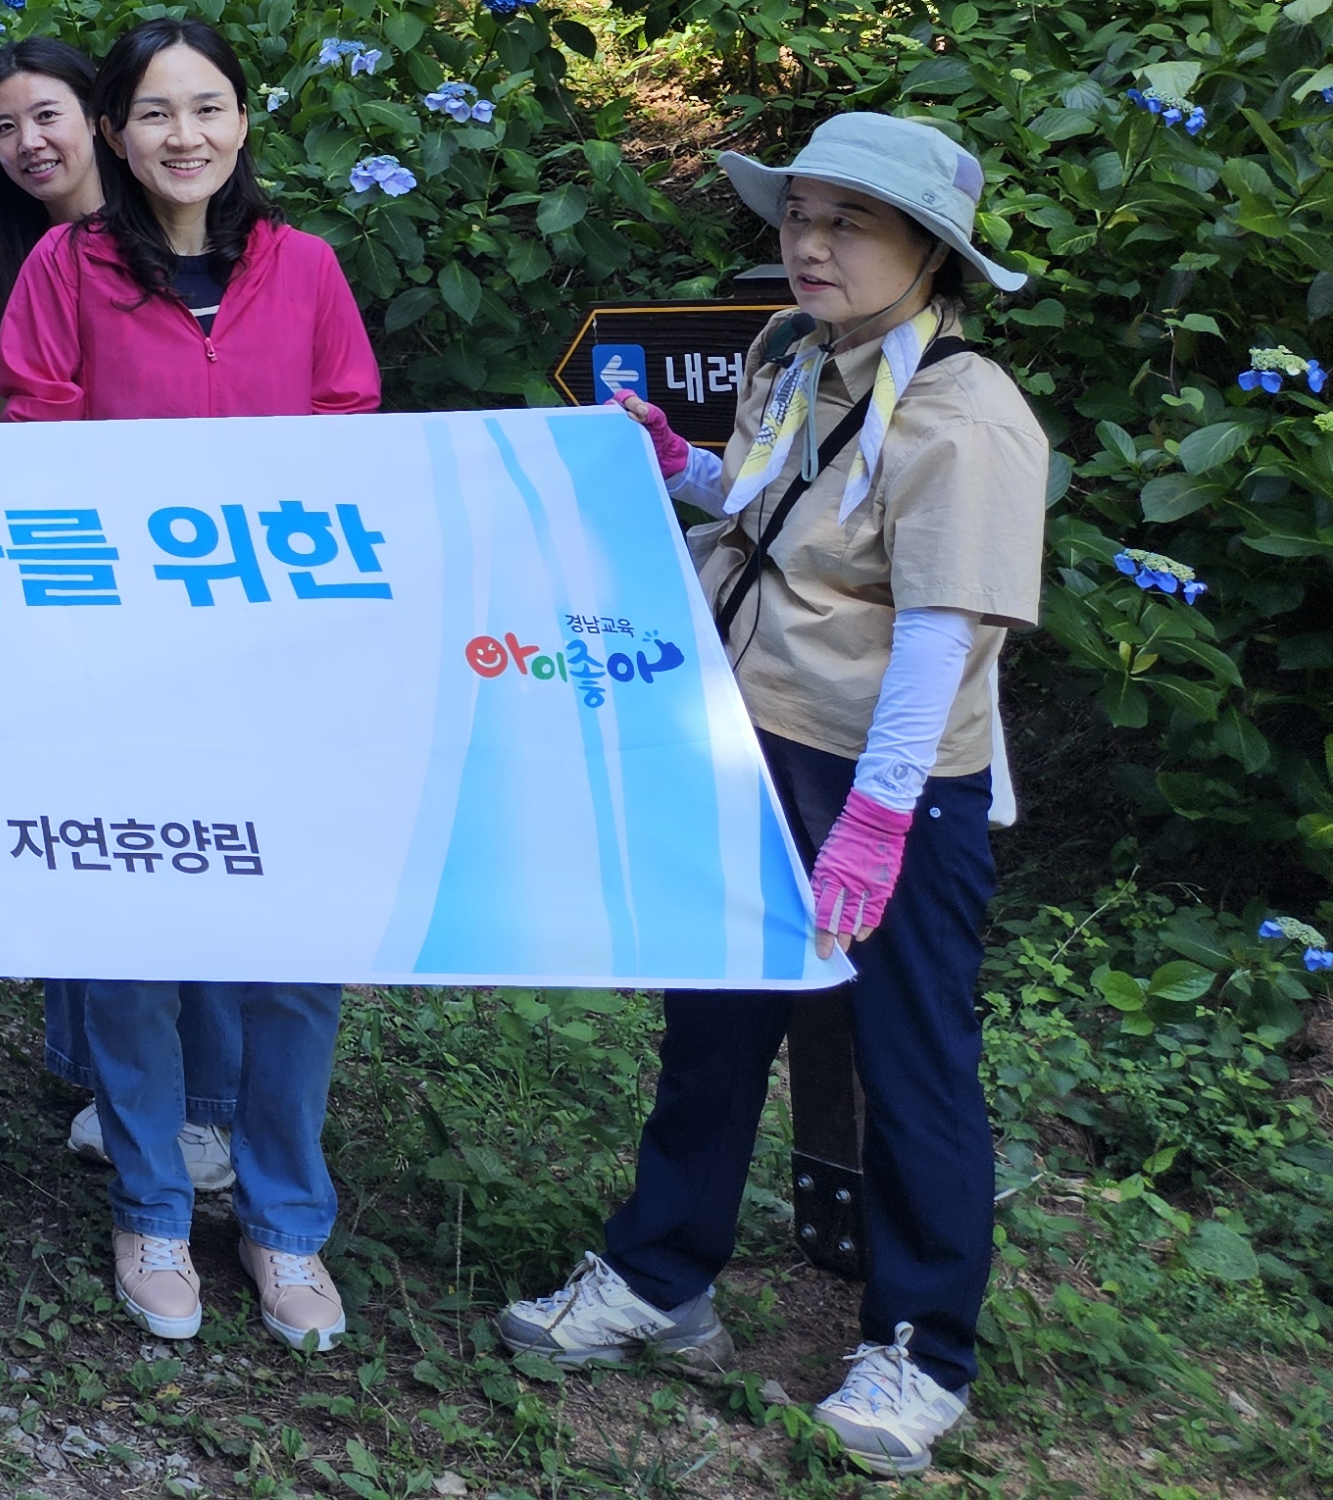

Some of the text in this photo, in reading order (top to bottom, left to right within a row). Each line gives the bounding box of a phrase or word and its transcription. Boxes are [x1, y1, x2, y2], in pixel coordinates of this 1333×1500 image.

[148, 500, 394, 608] 위한
[564, 613, 635, 638] 경남교육
[464, 631, 685, 709] 아이좋아
[6, 815, 265, 876] 자연휴양림
